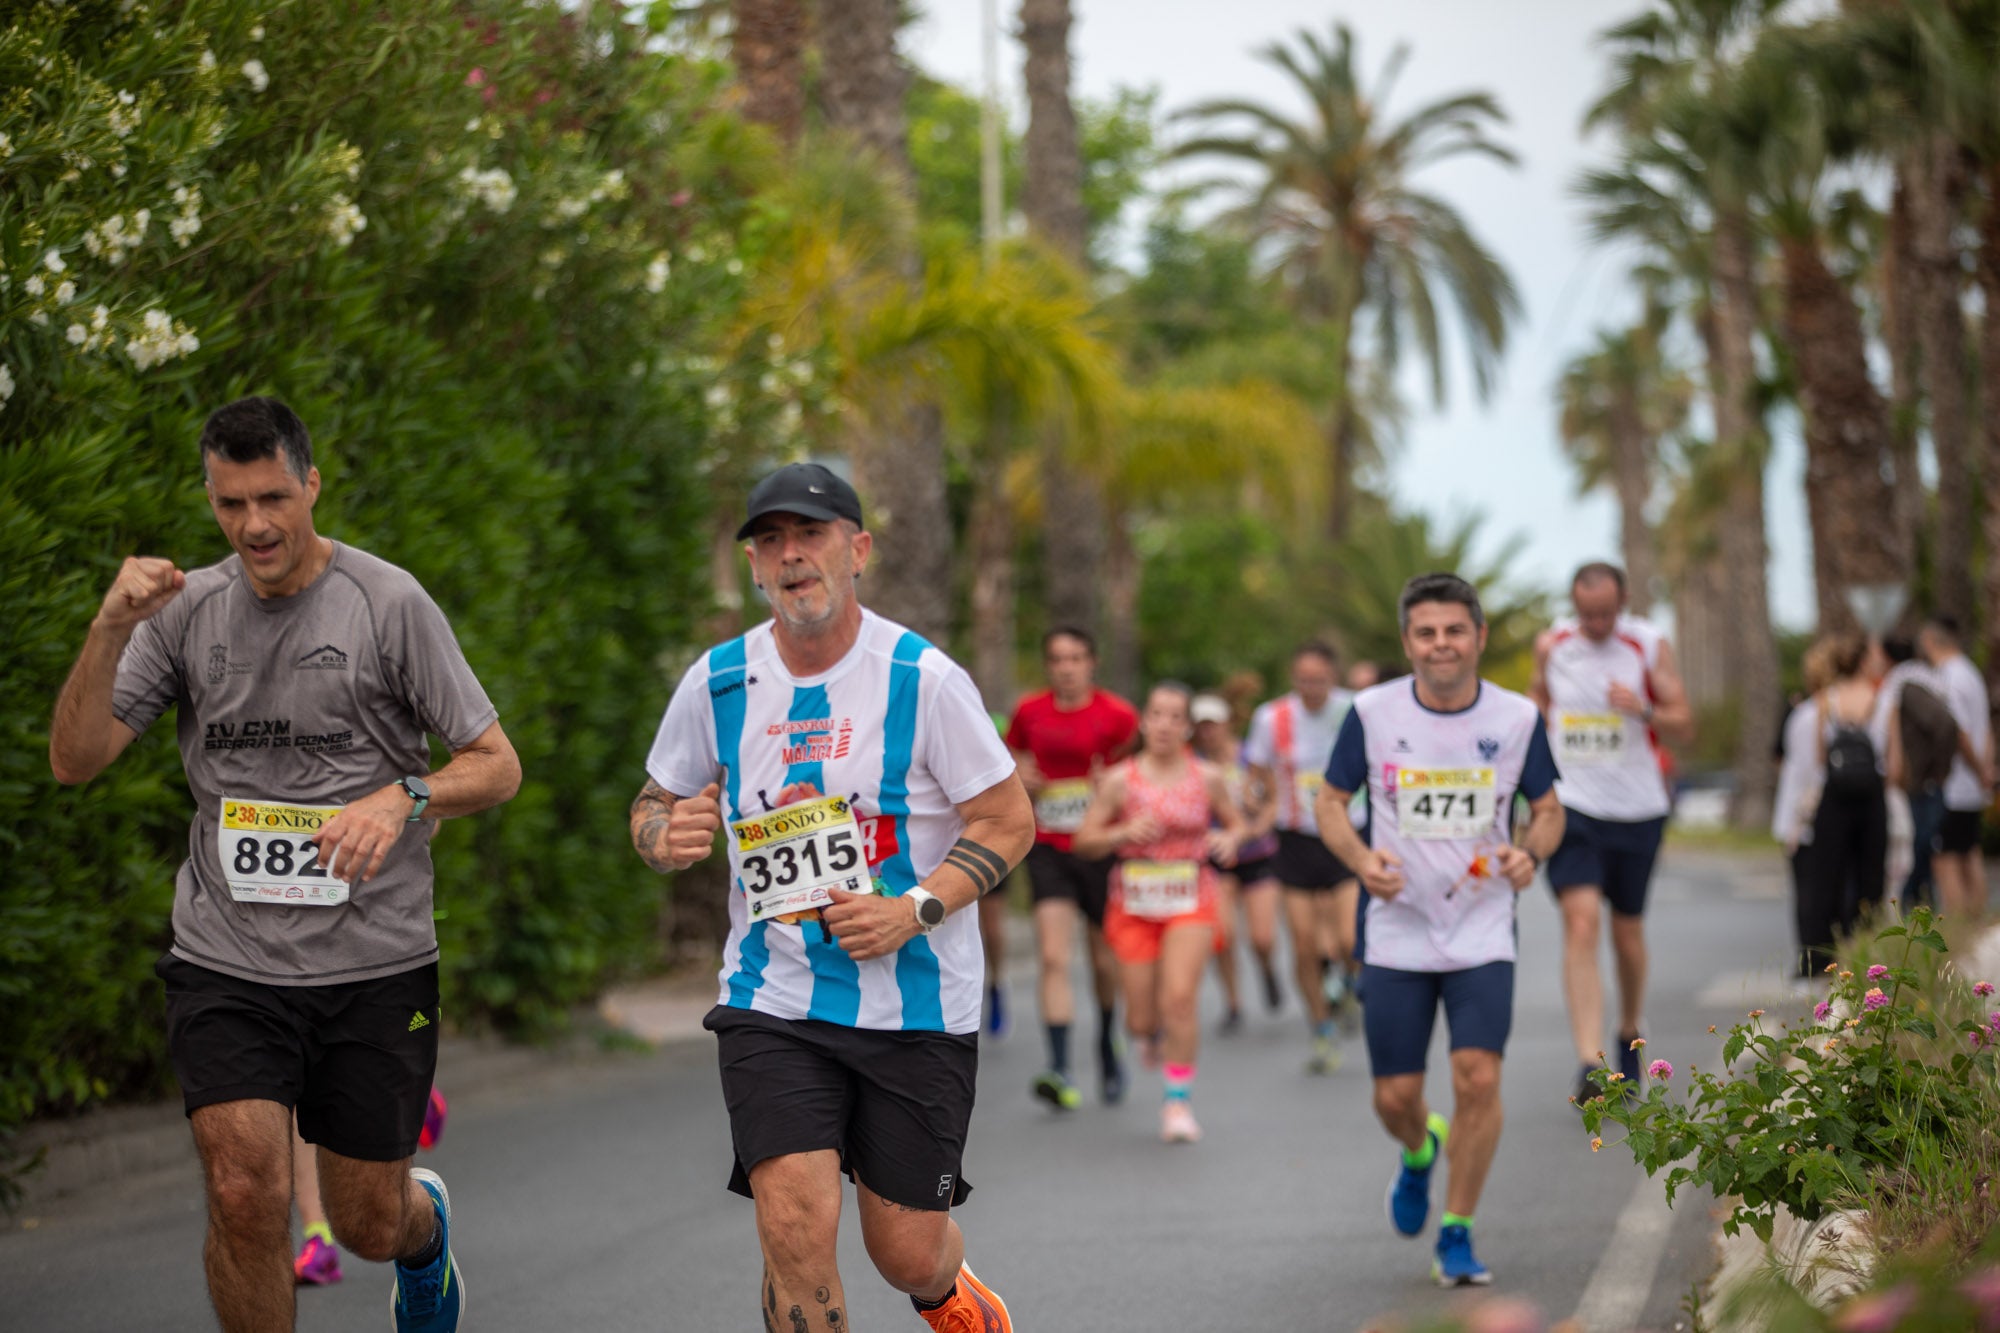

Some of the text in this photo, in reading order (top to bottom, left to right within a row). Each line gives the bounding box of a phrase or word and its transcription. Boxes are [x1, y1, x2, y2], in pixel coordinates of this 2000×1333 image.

[206, 719, 291, 738] IV CXM
[782, 720, 834, 733] GENERALI
[205, 730, 353, 750] SIERRA DE CENES
[782, 743, 832, 764] MÁLAGA
[238, 806, 256, 824] 38
[260, 806, 282, 815] GRAN
[284, 808, 317, 818] PREMIO
[764, 812, 788, 826] GRAN
[788, 806, 816, 818] PREMIO
[1413, 793, 1476, 819] 471
[255, 812, 323, 829] FONDO
[763, 810, 825, 838] FONDO
[745, 823, 764, 843] 38
[234, 837, 328, 878] 882
[743, 830, 858, 894] 3315
